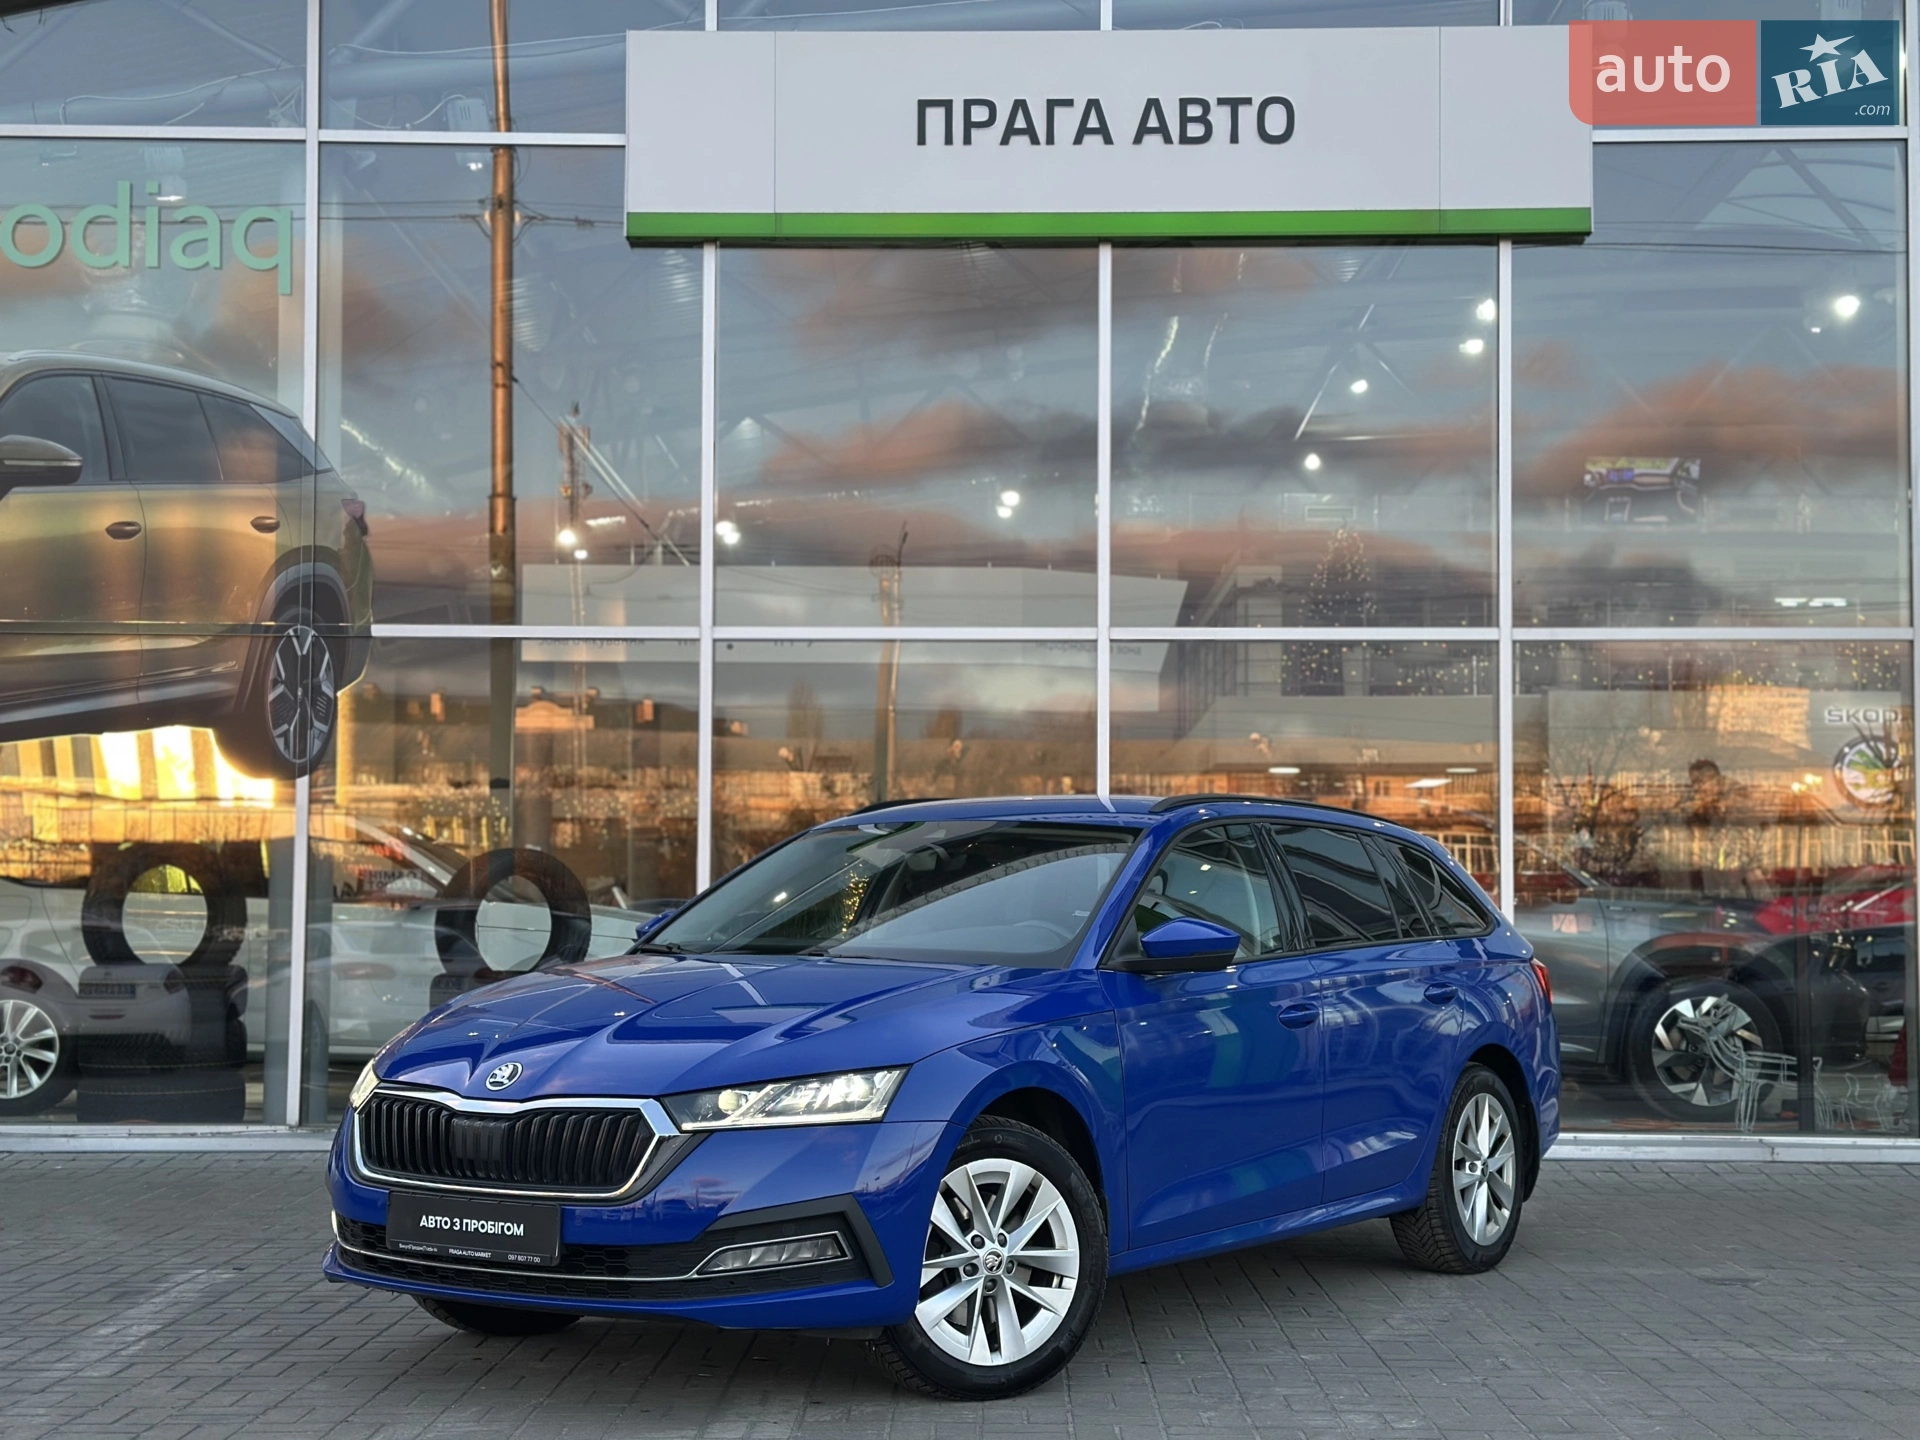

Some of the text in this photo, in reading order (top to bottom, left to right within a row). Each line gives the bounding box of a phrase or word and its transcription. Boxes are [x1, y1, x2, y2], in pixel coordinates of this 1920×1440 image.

[916, 95, 1295, 146] ПРАГА АВТО
[420, 1215, 451, 1229] АВТО
[463, 1219, 524, 1236] ПРОБІГОМ
